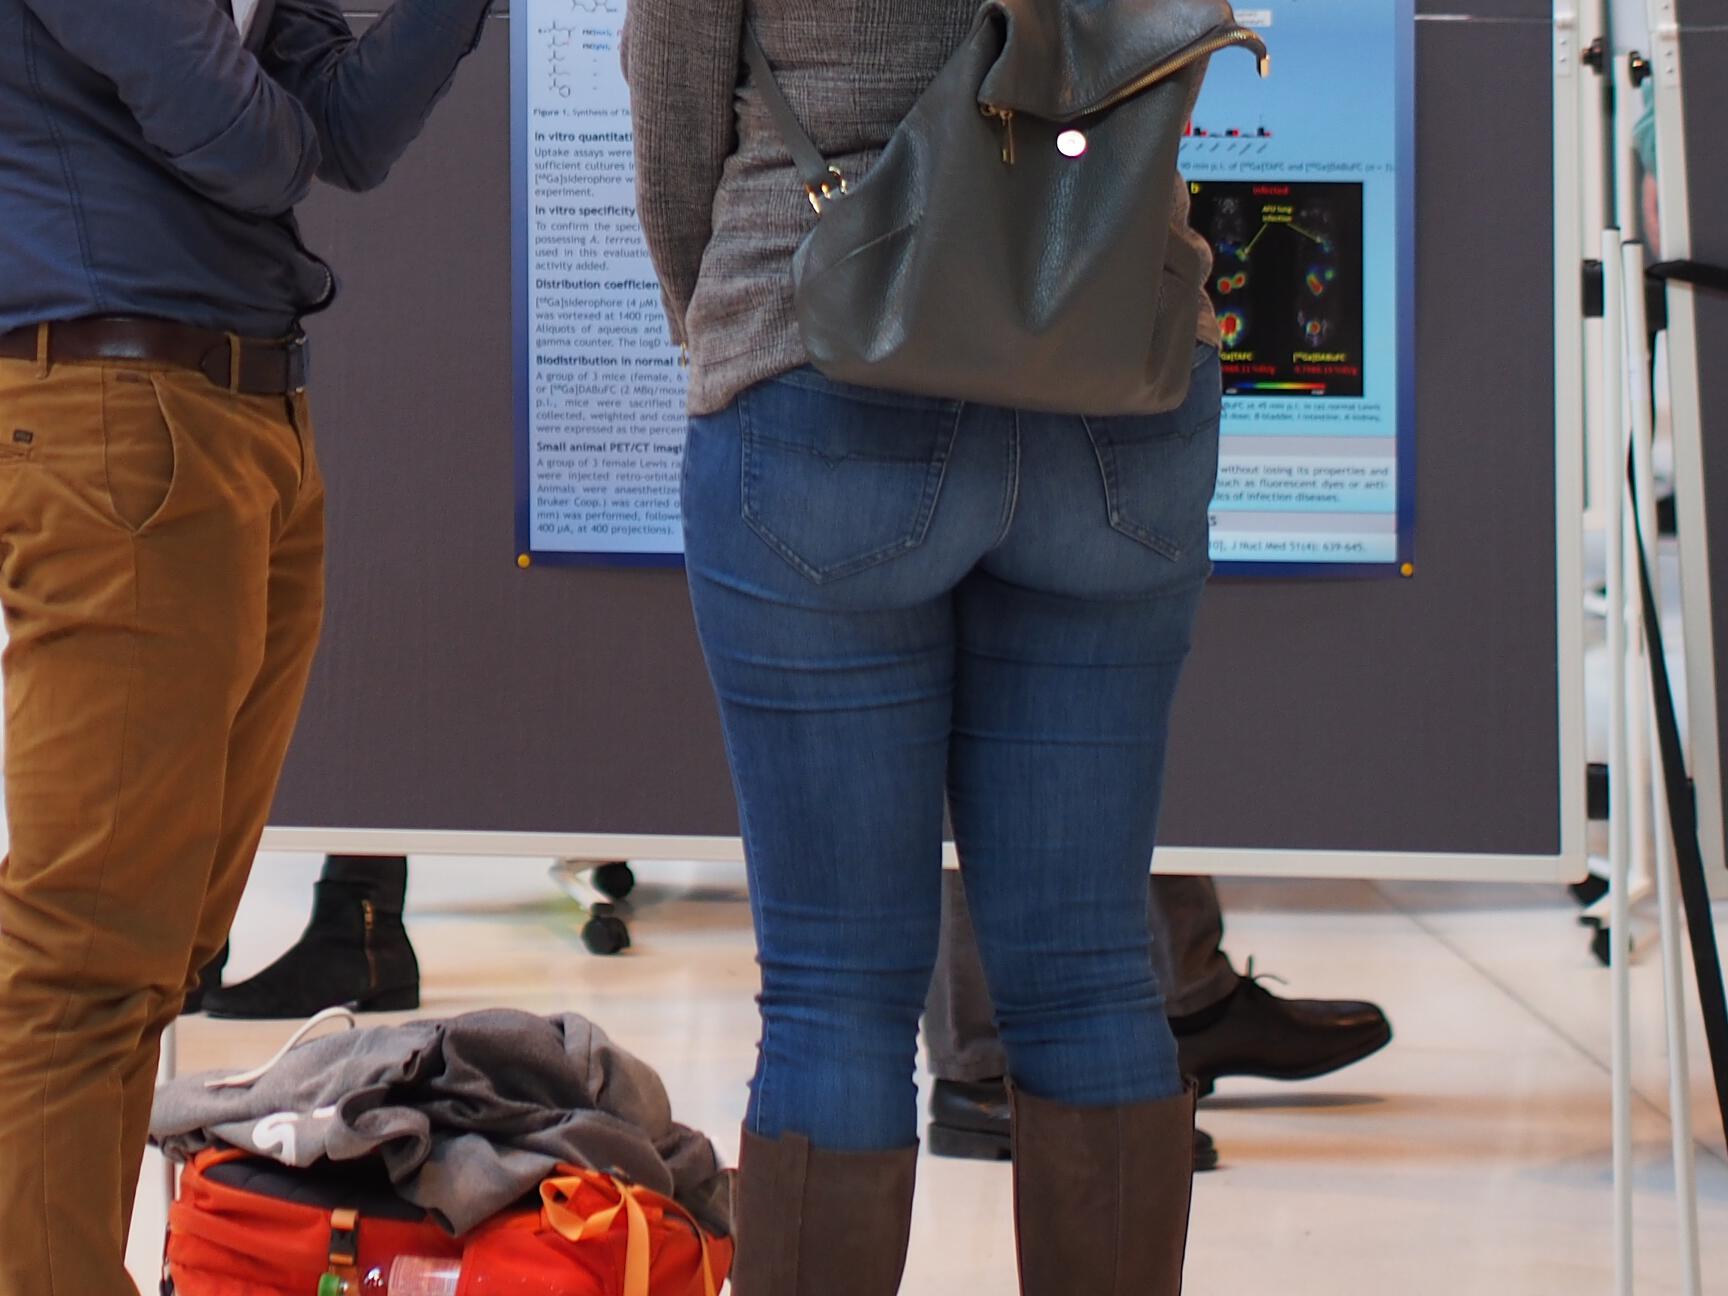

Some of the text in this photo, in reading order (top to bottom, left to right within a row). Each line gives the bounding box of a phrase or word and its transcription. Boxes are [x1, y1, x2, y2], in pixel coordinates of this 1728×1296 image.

[534, 131, 575, 141] In vitro
[535, 205, 635, 217] In vitro specificity
[535, 279, 600, 289] Distribution
[536, 355, 673, 366] Biodistribution in normal
[536, 441, 650, 452] Small animal PET/CT
